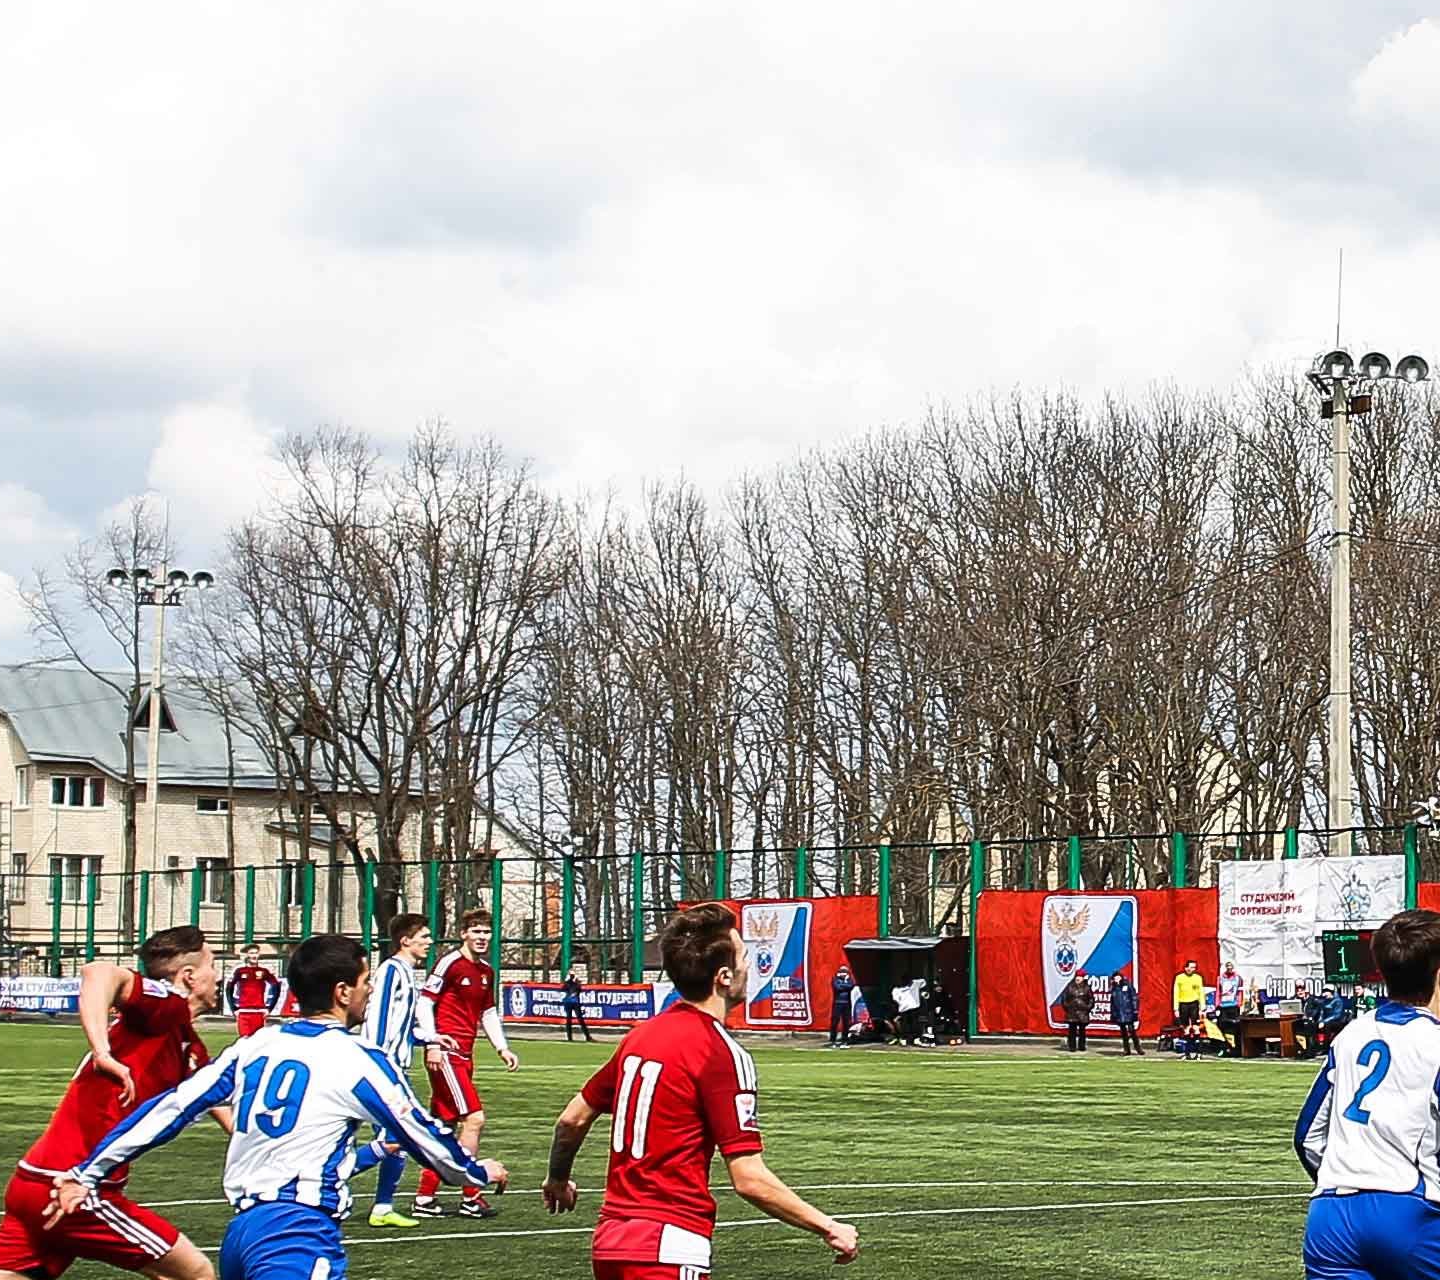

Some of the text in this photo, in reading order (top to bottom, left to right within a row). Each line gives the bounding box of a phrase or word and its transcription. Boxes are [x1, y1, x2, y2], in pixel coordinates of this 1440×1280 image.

[1337, 946, 1349, 972] 1
[236, 1055, 311, 1139] 19
[613, 1055, 663, 1159] 11
[1343, 1039, 1391, 1125] 2
